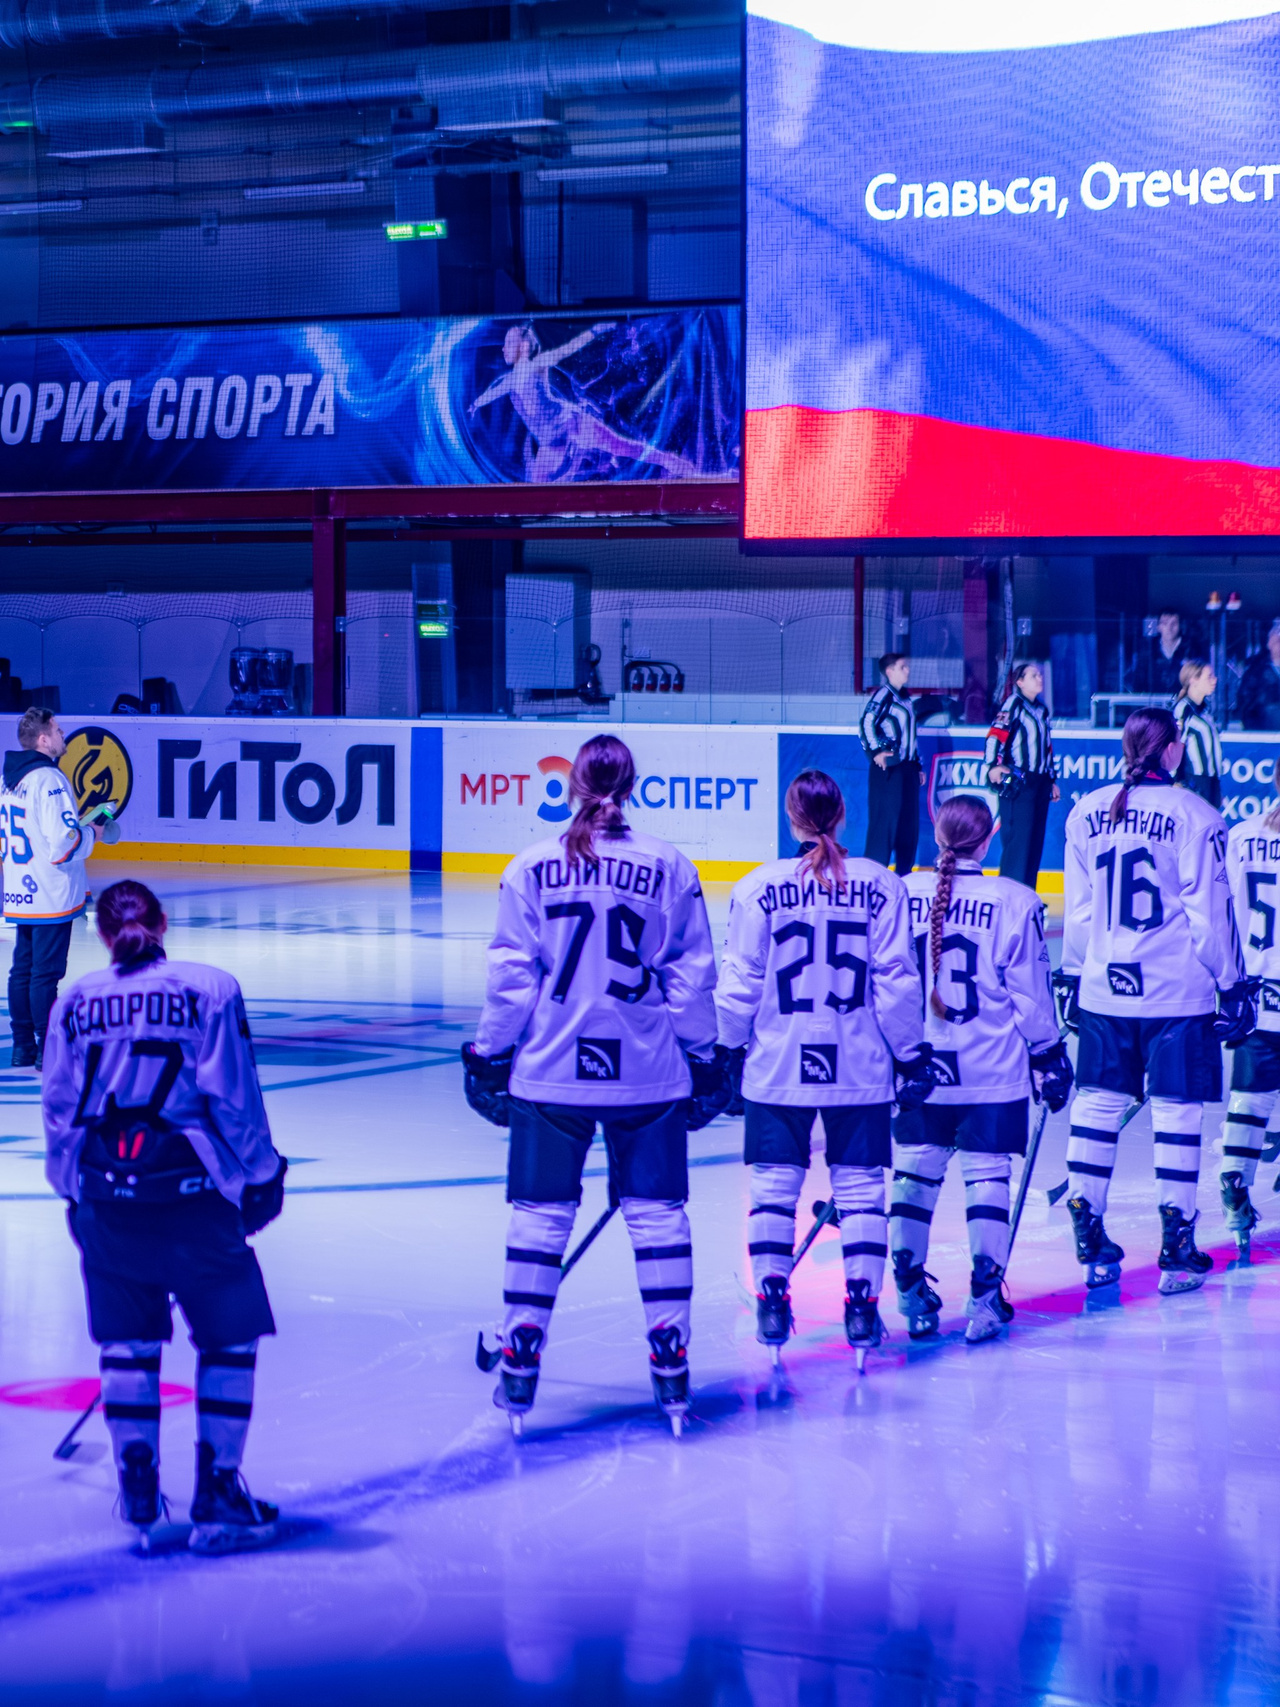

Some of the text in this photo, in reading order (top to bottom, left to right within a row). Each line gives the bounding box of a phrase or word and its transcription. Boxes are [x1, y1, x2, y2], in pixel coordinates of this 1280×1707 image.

[864, 172, 1069, 220] Славься,
[146, 373, 336, 440] СПОРТА
[460, 773, 531, 806] МРТ
[1095, 845, 1164, 934] 16
[544, 900, 652, 1006] 79
[771, 919, 869, 1016] 25
